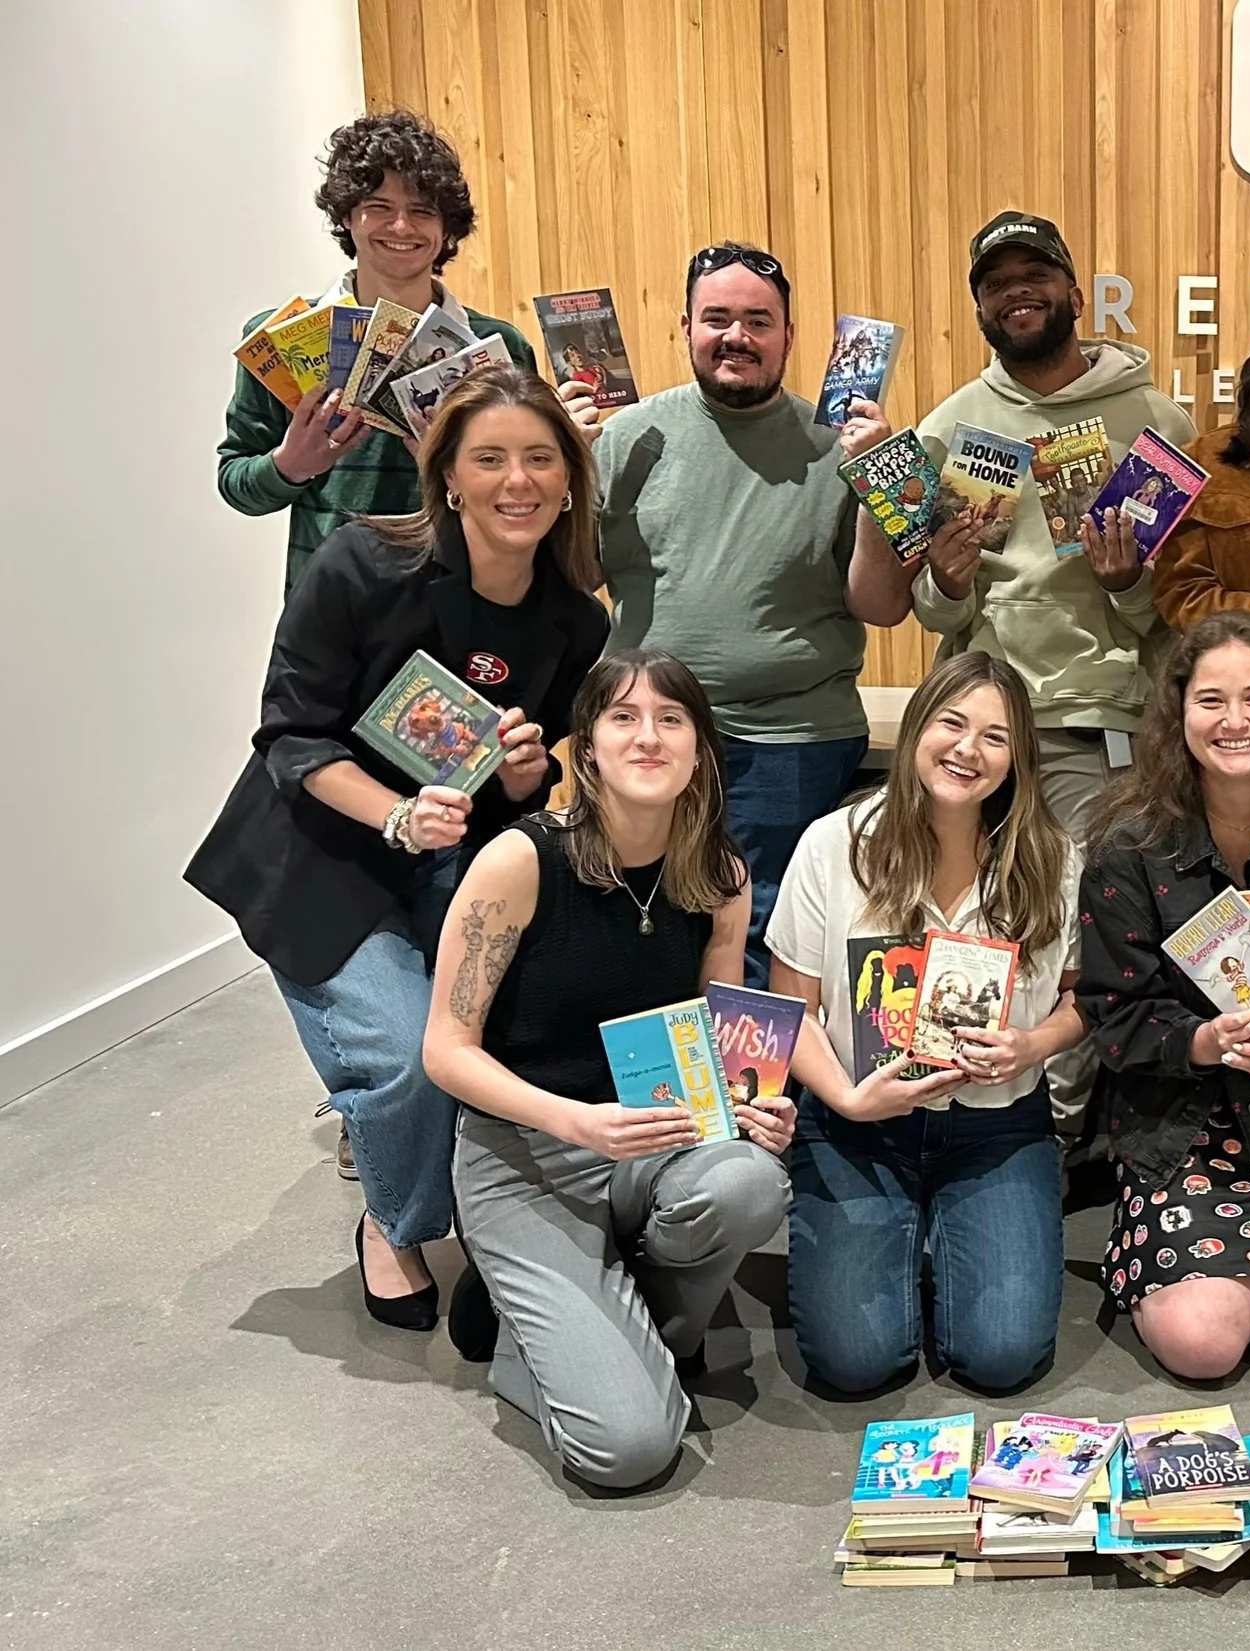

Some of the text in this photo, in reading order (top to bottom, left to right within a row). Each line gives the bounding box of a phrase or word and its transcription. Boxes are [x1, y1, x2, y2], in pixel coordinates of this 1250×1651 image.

[1007, 224, 1037, 234] BARN
[281, 322, 307, 341] MEG
[823, 376, 880, 392] GAMER ARMY
[865, 442, 910, 475] SUPER
[960, 440, 1019, 470] BOUND
[1155, 452, 1175, 471] DUMB
[878, 463, 911, 490] BABY
[952, 460, 1019, 489] FOR HOME
[379, 708, 401, 733] DOG
[394, 673, 432, 711] DIARIES
[1168, 896, 1242, 960] BEVERLY CLEARY
[1223, 913, 1249, 936] World
[671, 1023, 723, 1137] BLUME
[1158, 1450, 1235, 1474] A DOG'S
[1151, 1464, 1250, 1490] PORPOISE
